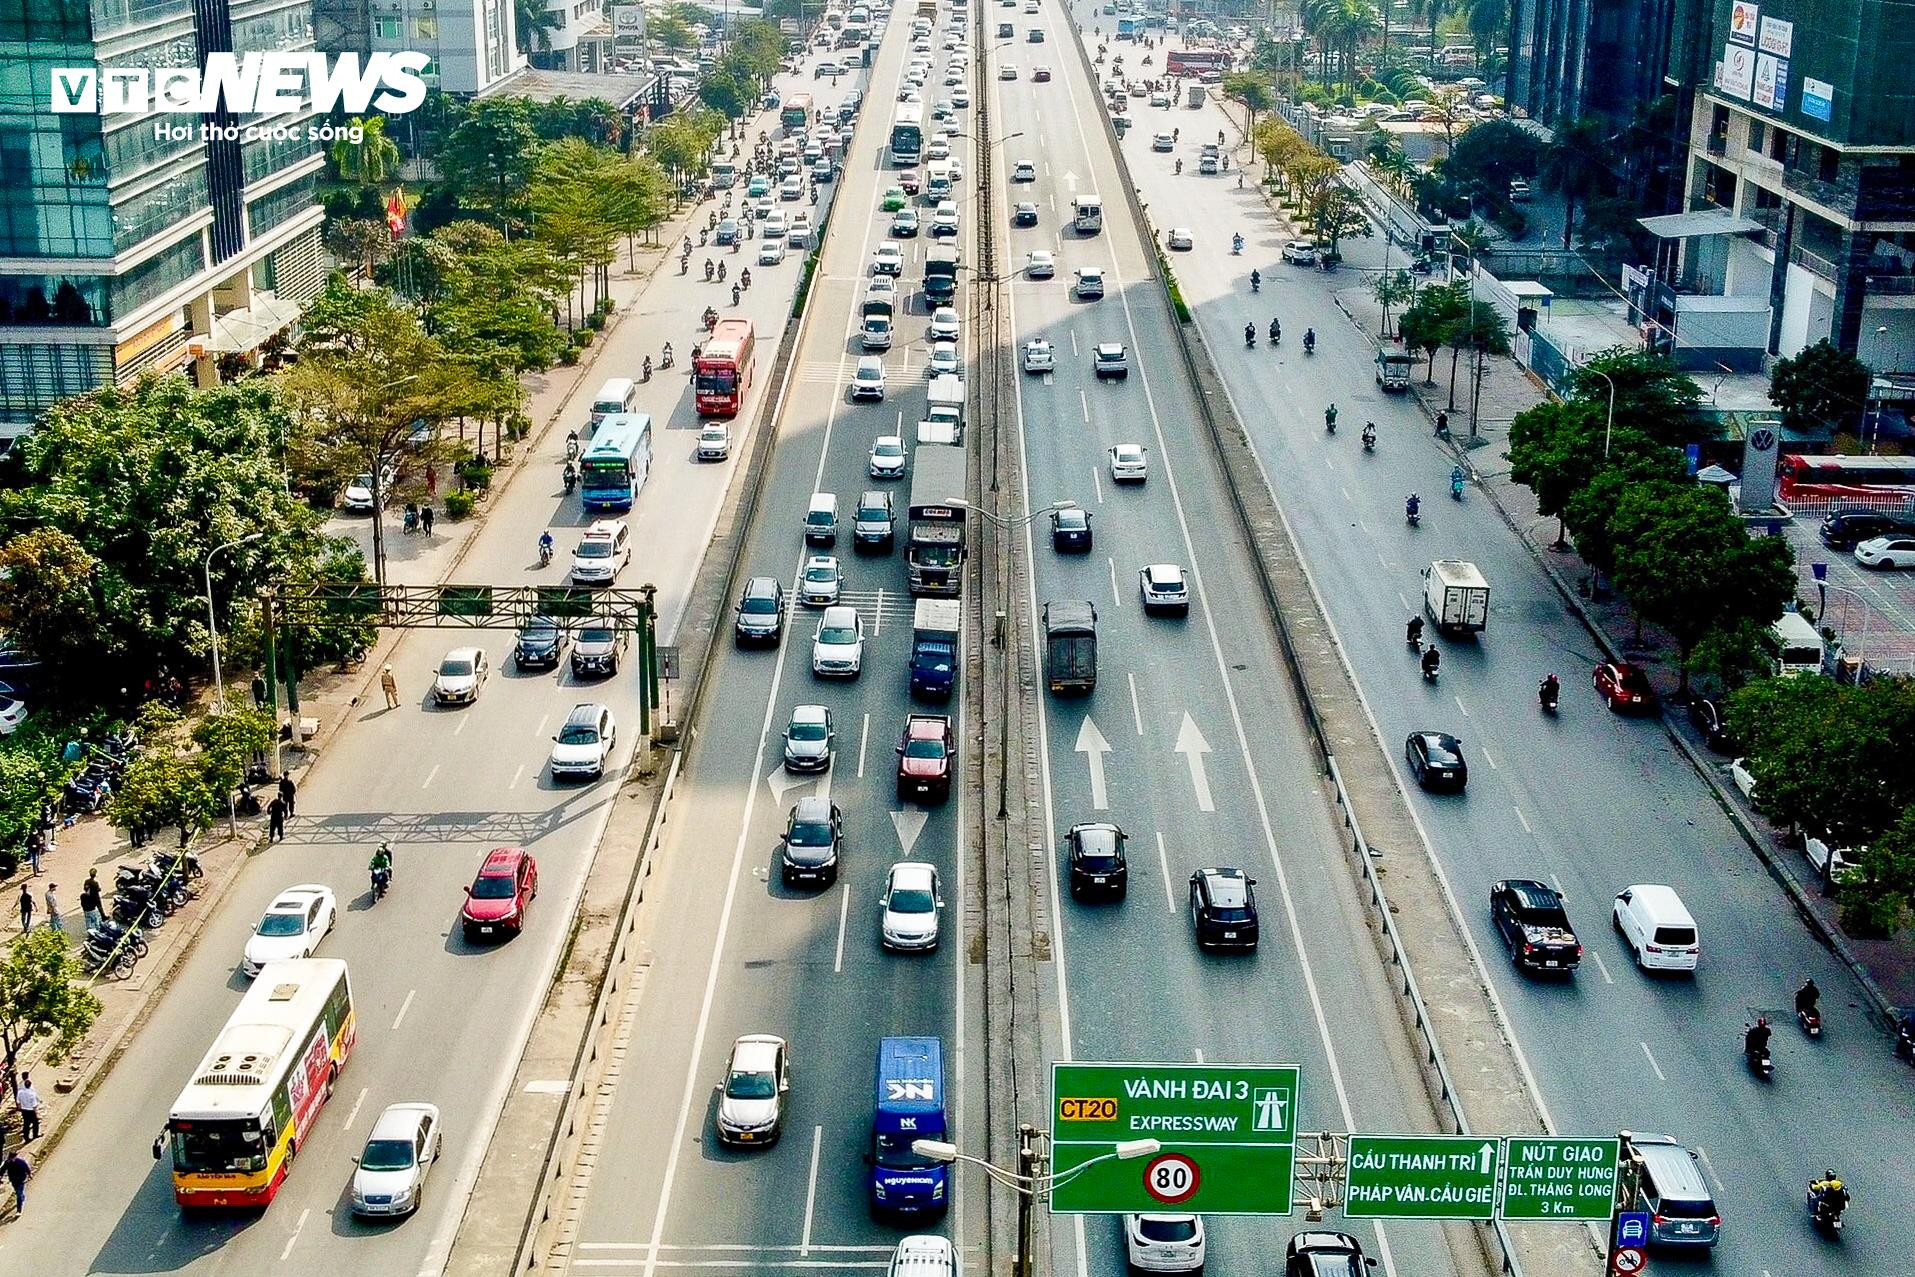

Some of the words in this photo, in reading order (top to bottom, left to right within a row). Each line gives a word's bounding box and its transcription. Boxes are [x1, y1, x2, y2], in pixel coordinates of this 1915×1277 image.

[1124, 1076, 1186, 1099] VÀNH
[1192, 1080, 1232, 1100] ĐAI
[1235, 1081, 1249, 1100] 3
[1130, 1116, 1239, 1131] EXPRESSWAY
[1522, 1142, 1558, 1162] NÚT
[1562, 1146, 1604, 1162] GIAO
[1389, 1154, 1446, 1170] THANH
[1449, 1153, 1476, 1171] TRÌ
[1156, 1167, 1187, 1189] 80
[1547, 1167, 1574, 1179] DUY
[1578, 1166, 1613, 1179] HƯNG
[1349, 1183, 1393, 1201] PHÁP
[1530, 1182, 1573, 1196] THĂNG
[1578, 1185, 1612, 1196] LONG
[1540, 1202, 1549, 1213] 3
[1553, 1202, 1574, 1213] Km
